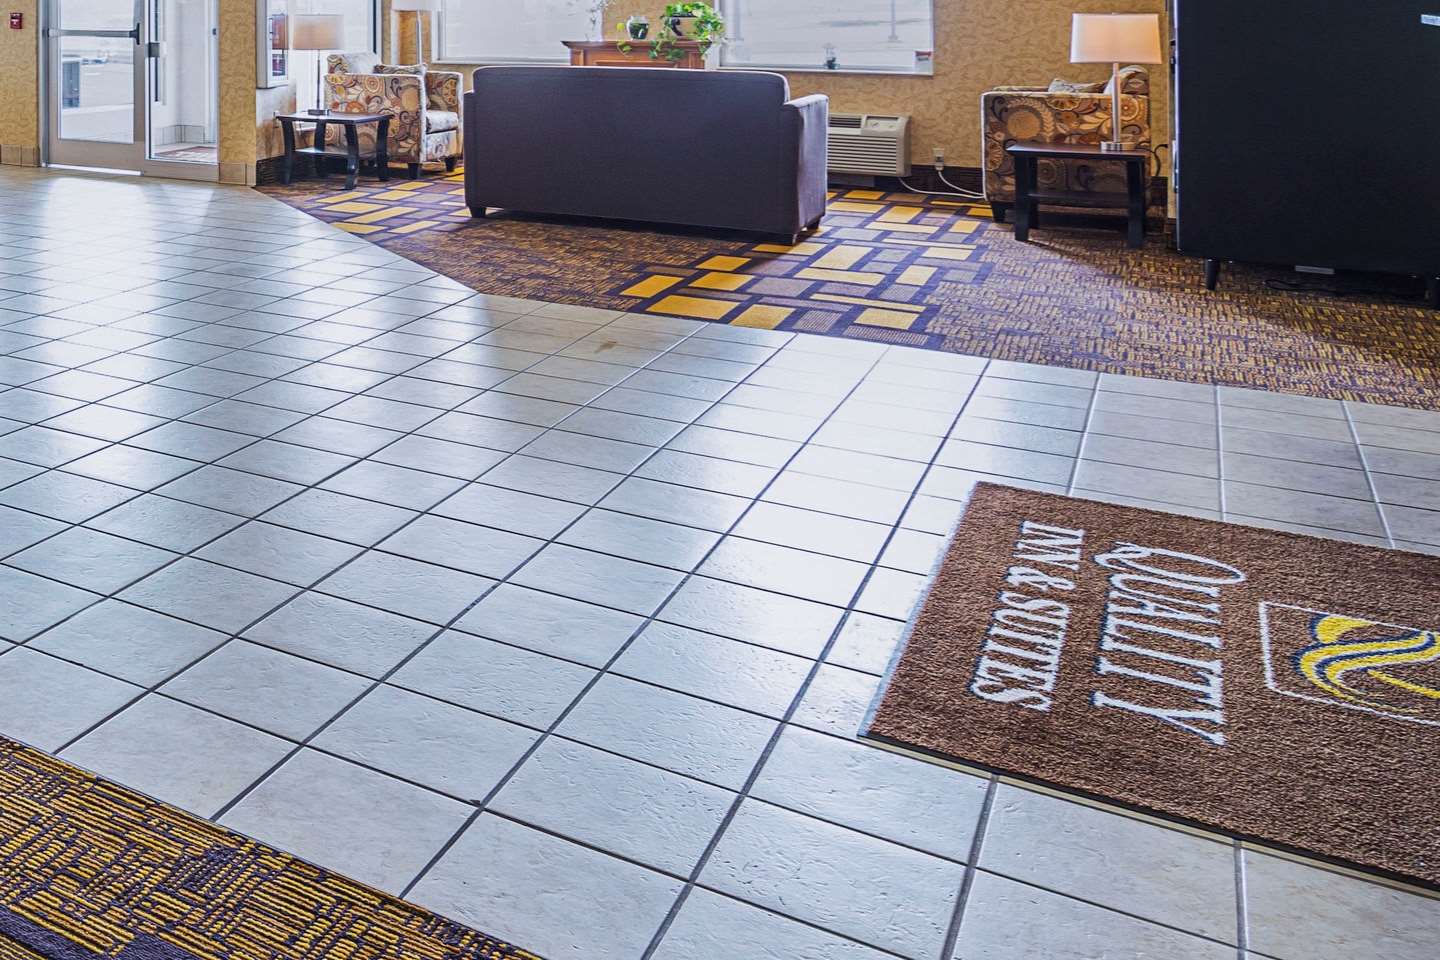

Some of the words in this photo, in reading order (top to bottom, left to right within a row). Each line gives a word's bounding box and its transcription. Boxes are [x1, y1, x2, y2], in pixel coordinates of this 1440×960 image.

[1005, 565, 1076, 593] &
[1013, 520, 1085, 571] INN
[968, 591, 1072, 713] SUITES
[1090, 541, 1246, 747] QUALITY
